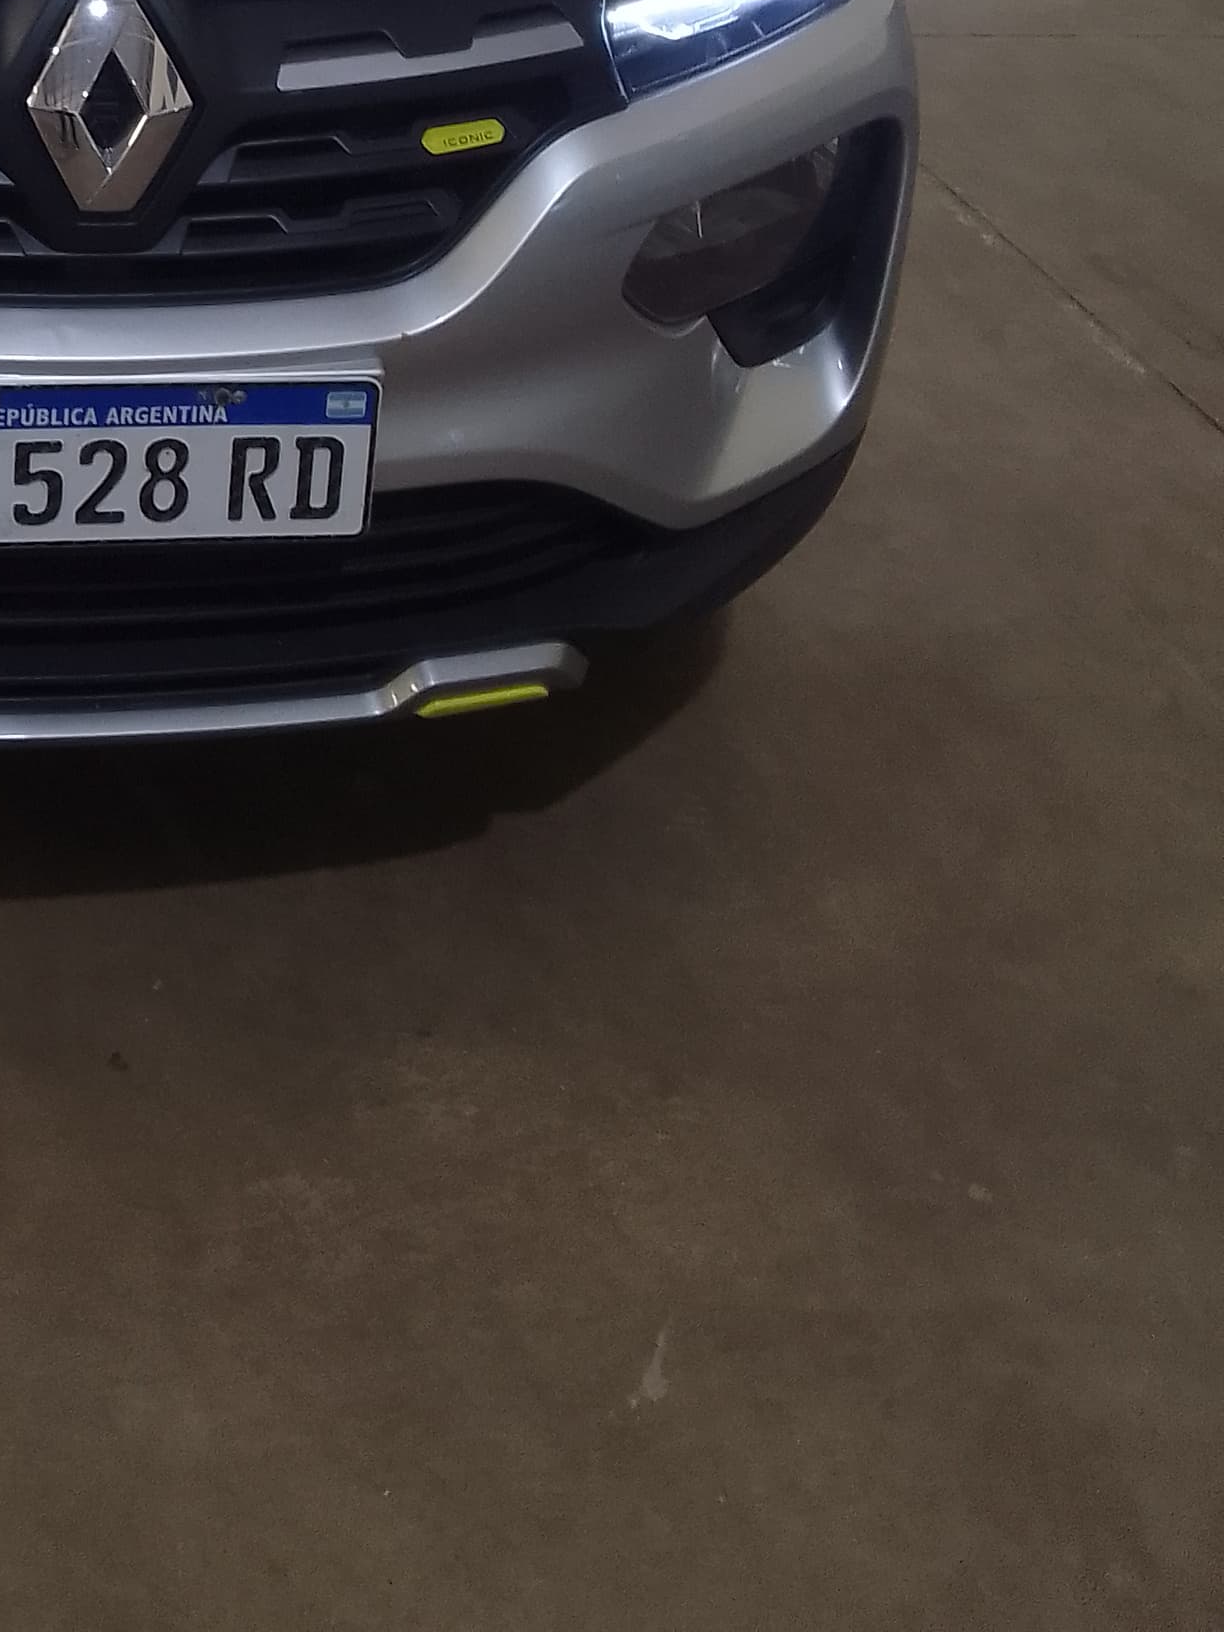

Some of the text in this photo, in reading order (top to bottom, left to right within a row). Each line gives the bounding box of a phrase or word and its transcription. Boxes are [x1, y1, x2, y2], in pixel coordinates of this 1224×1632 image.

[443, 131, 494, 147] ICONIC
[104, 404, 229, 426] ARGENTINA
[11, 438, 191, 527] 528
[226, 435, 346, 522] RD
